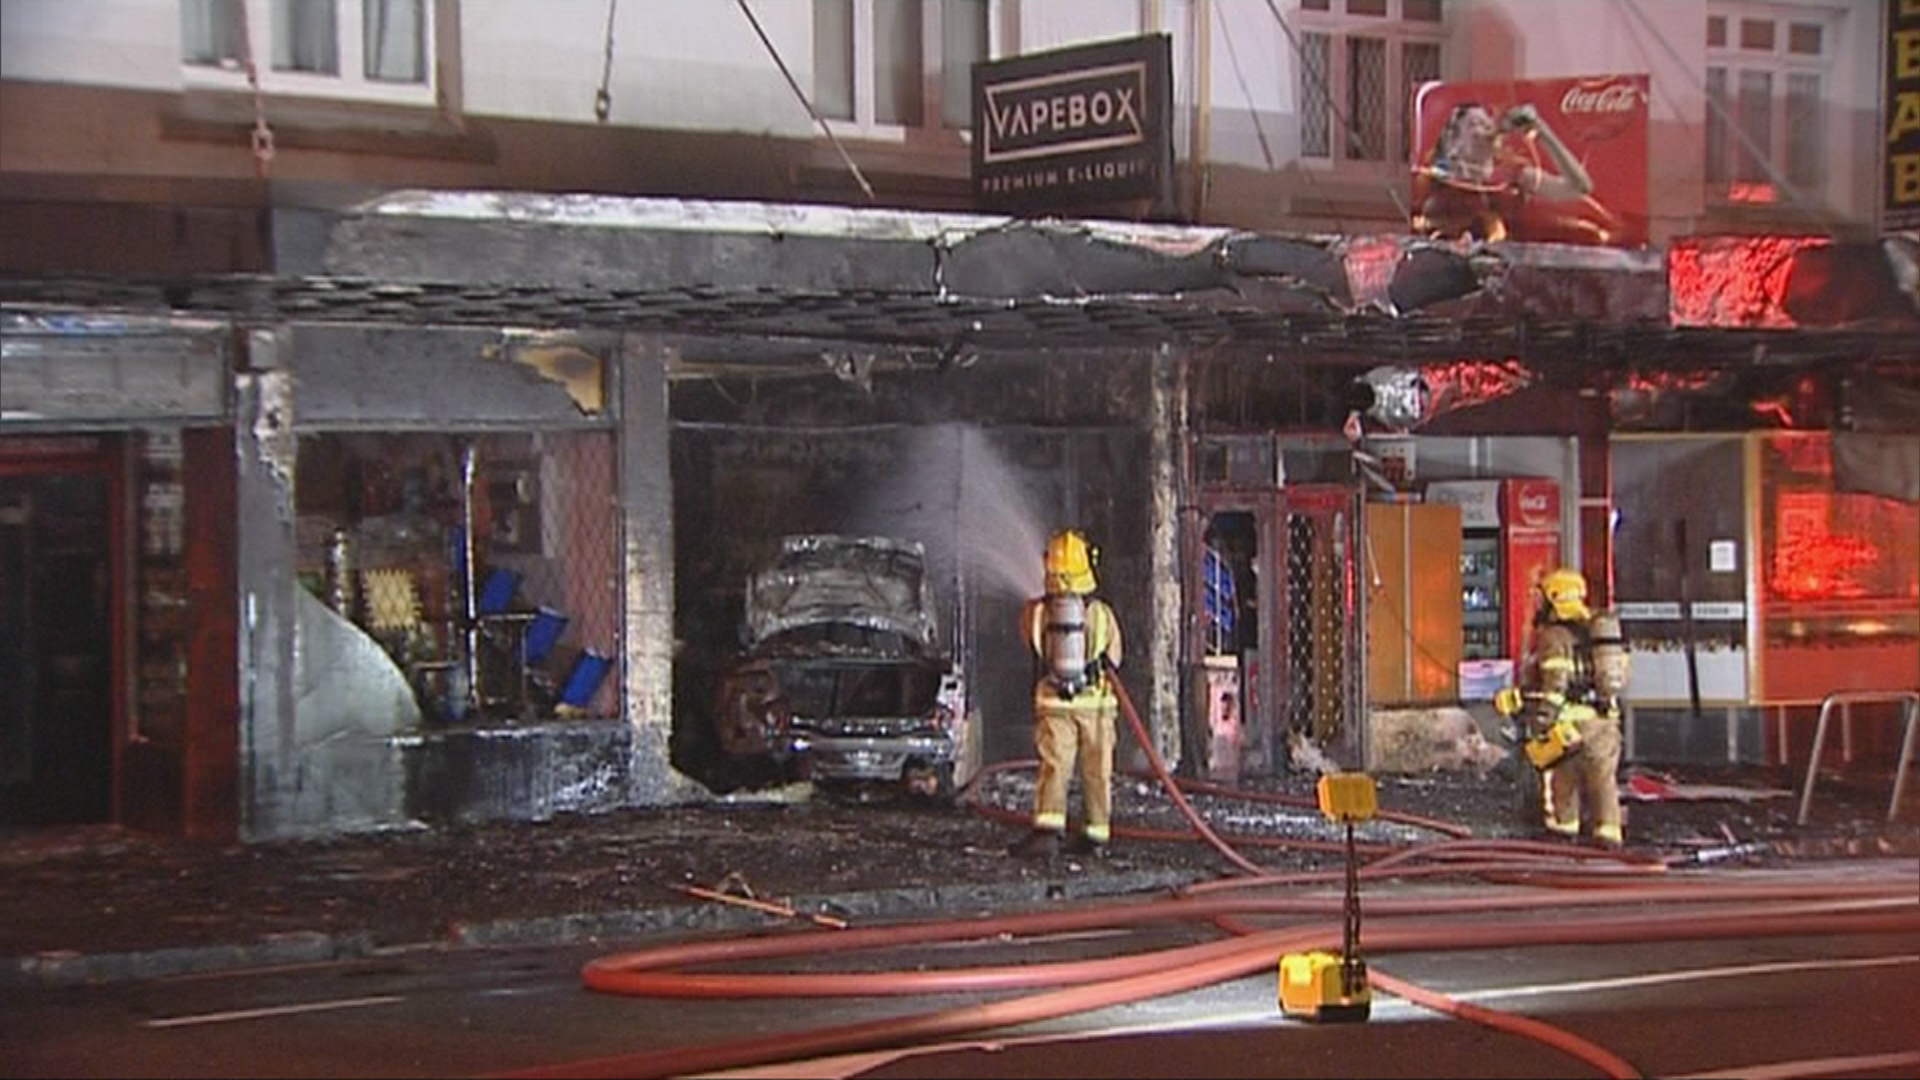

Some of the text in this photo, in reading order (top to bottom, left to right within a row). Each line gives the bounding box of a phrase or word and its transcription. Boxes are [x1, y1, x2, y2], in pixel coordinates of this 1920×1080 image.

[994, 88, 1134, 139] VAPEBOX
[982, 158, 1156, 192] PREMIUM E-LIQUI
